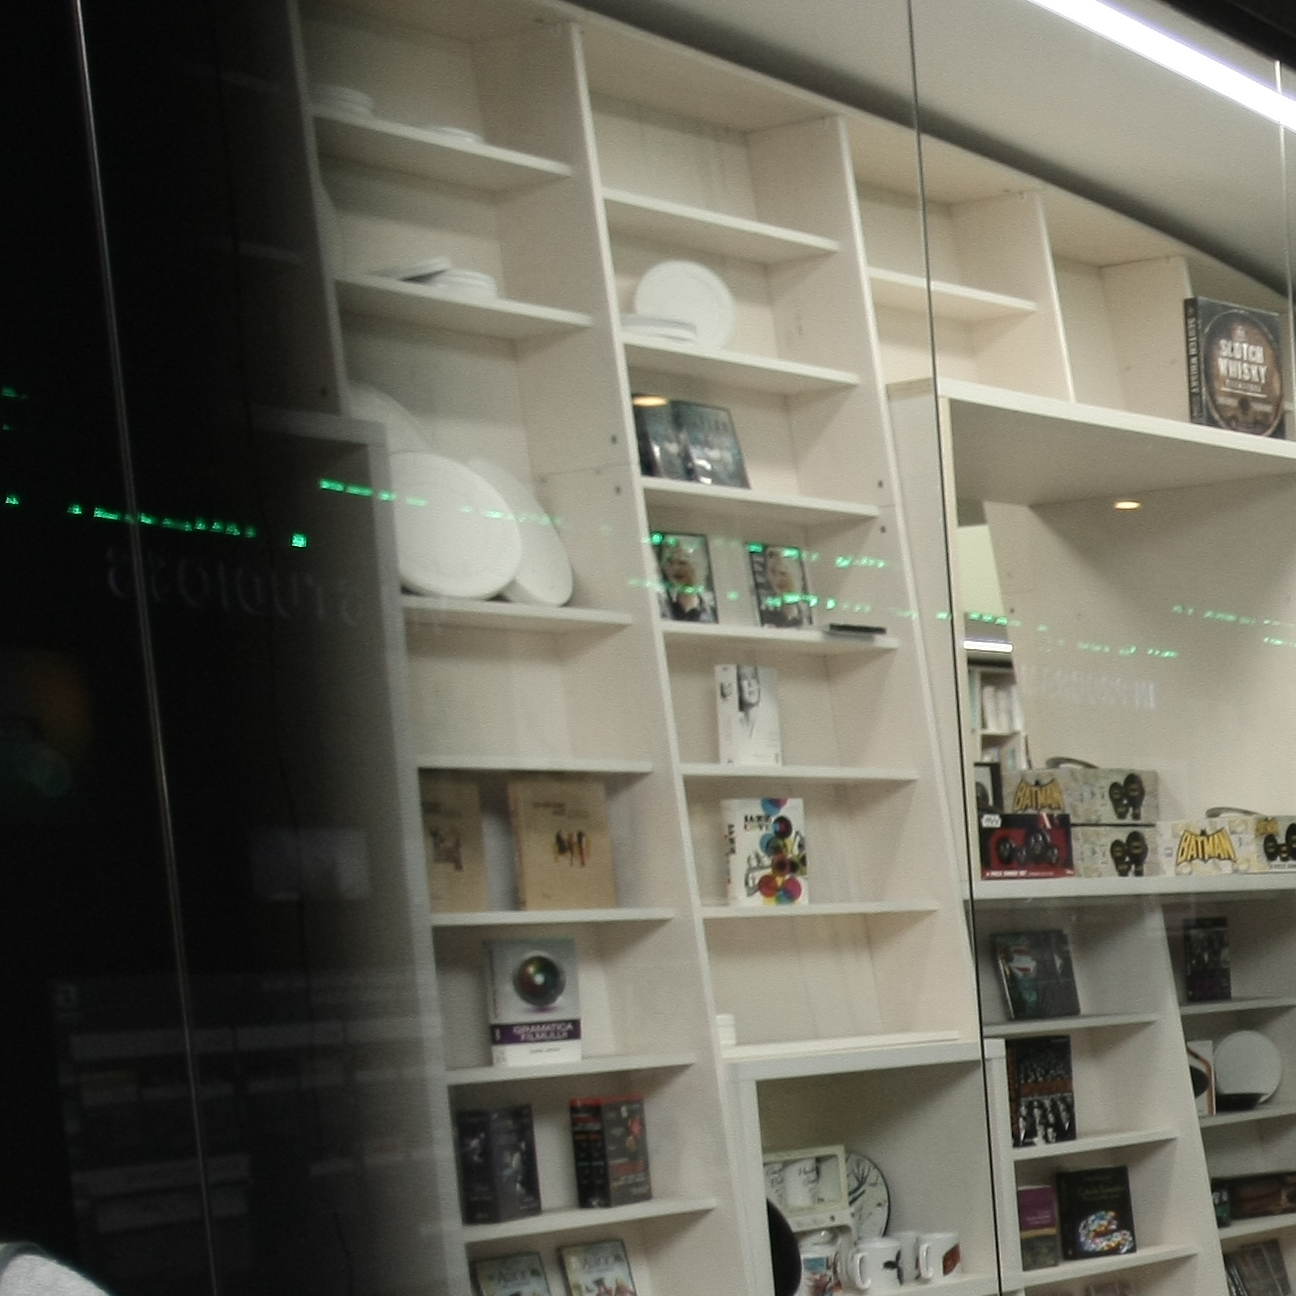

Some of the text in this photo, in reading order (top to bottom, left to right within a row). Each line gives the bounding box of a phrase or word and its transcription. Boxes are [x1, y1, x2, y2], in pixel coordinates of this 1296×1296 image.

[1219, 338, 1265, 364] SCOTCH
[1217, 357, 1268, 384] WHISKY
[1013, 777, 1064, 815] BATMAN
[1177, 827, 1237, 867] BATMAN
